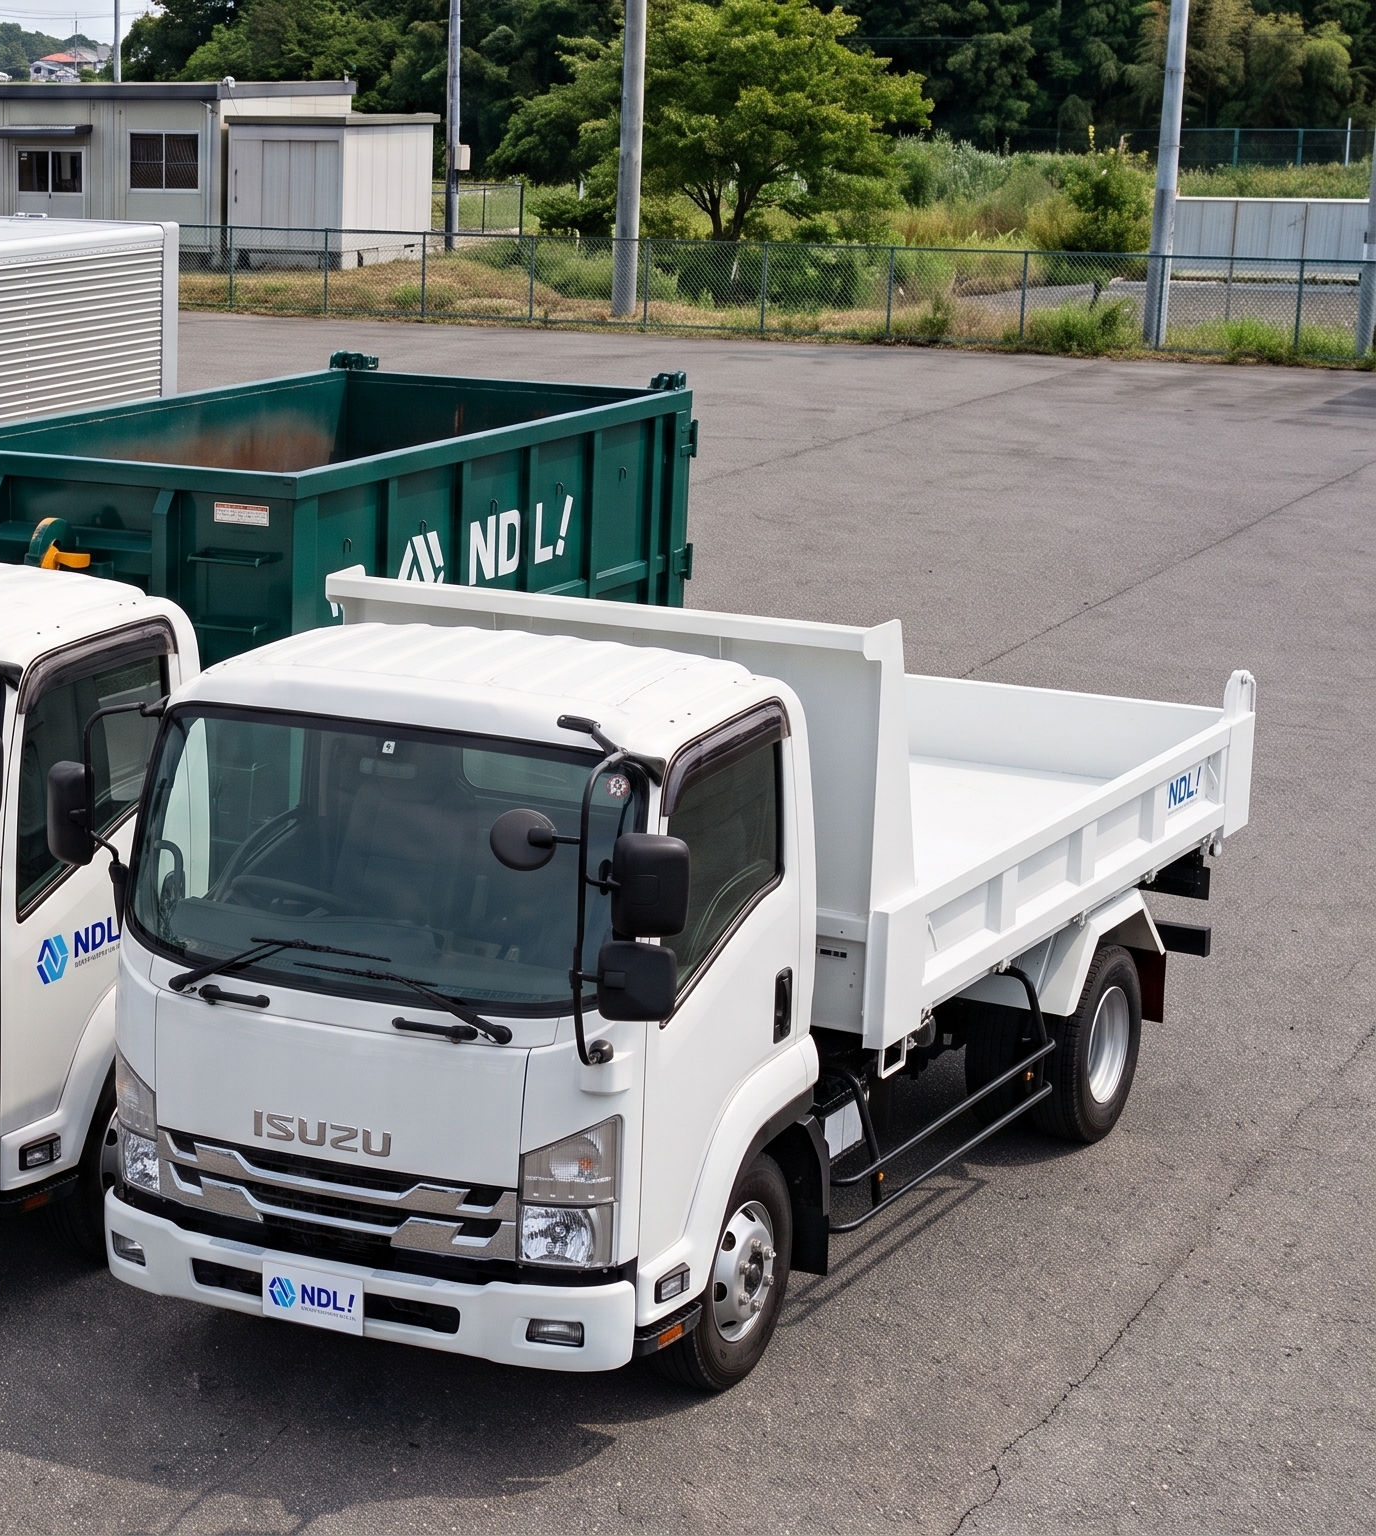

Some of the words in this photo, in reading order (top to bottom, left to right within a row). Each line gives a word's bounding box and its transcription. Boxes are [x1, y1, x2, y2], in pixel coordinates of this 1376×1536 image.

[1168, 765, 1201, 809] NDL!
[74, 916, 121, 958] NDL
[253, 1109, 392, 1158] ISUZU
[301, 1283, 356, 1313] NDL!
